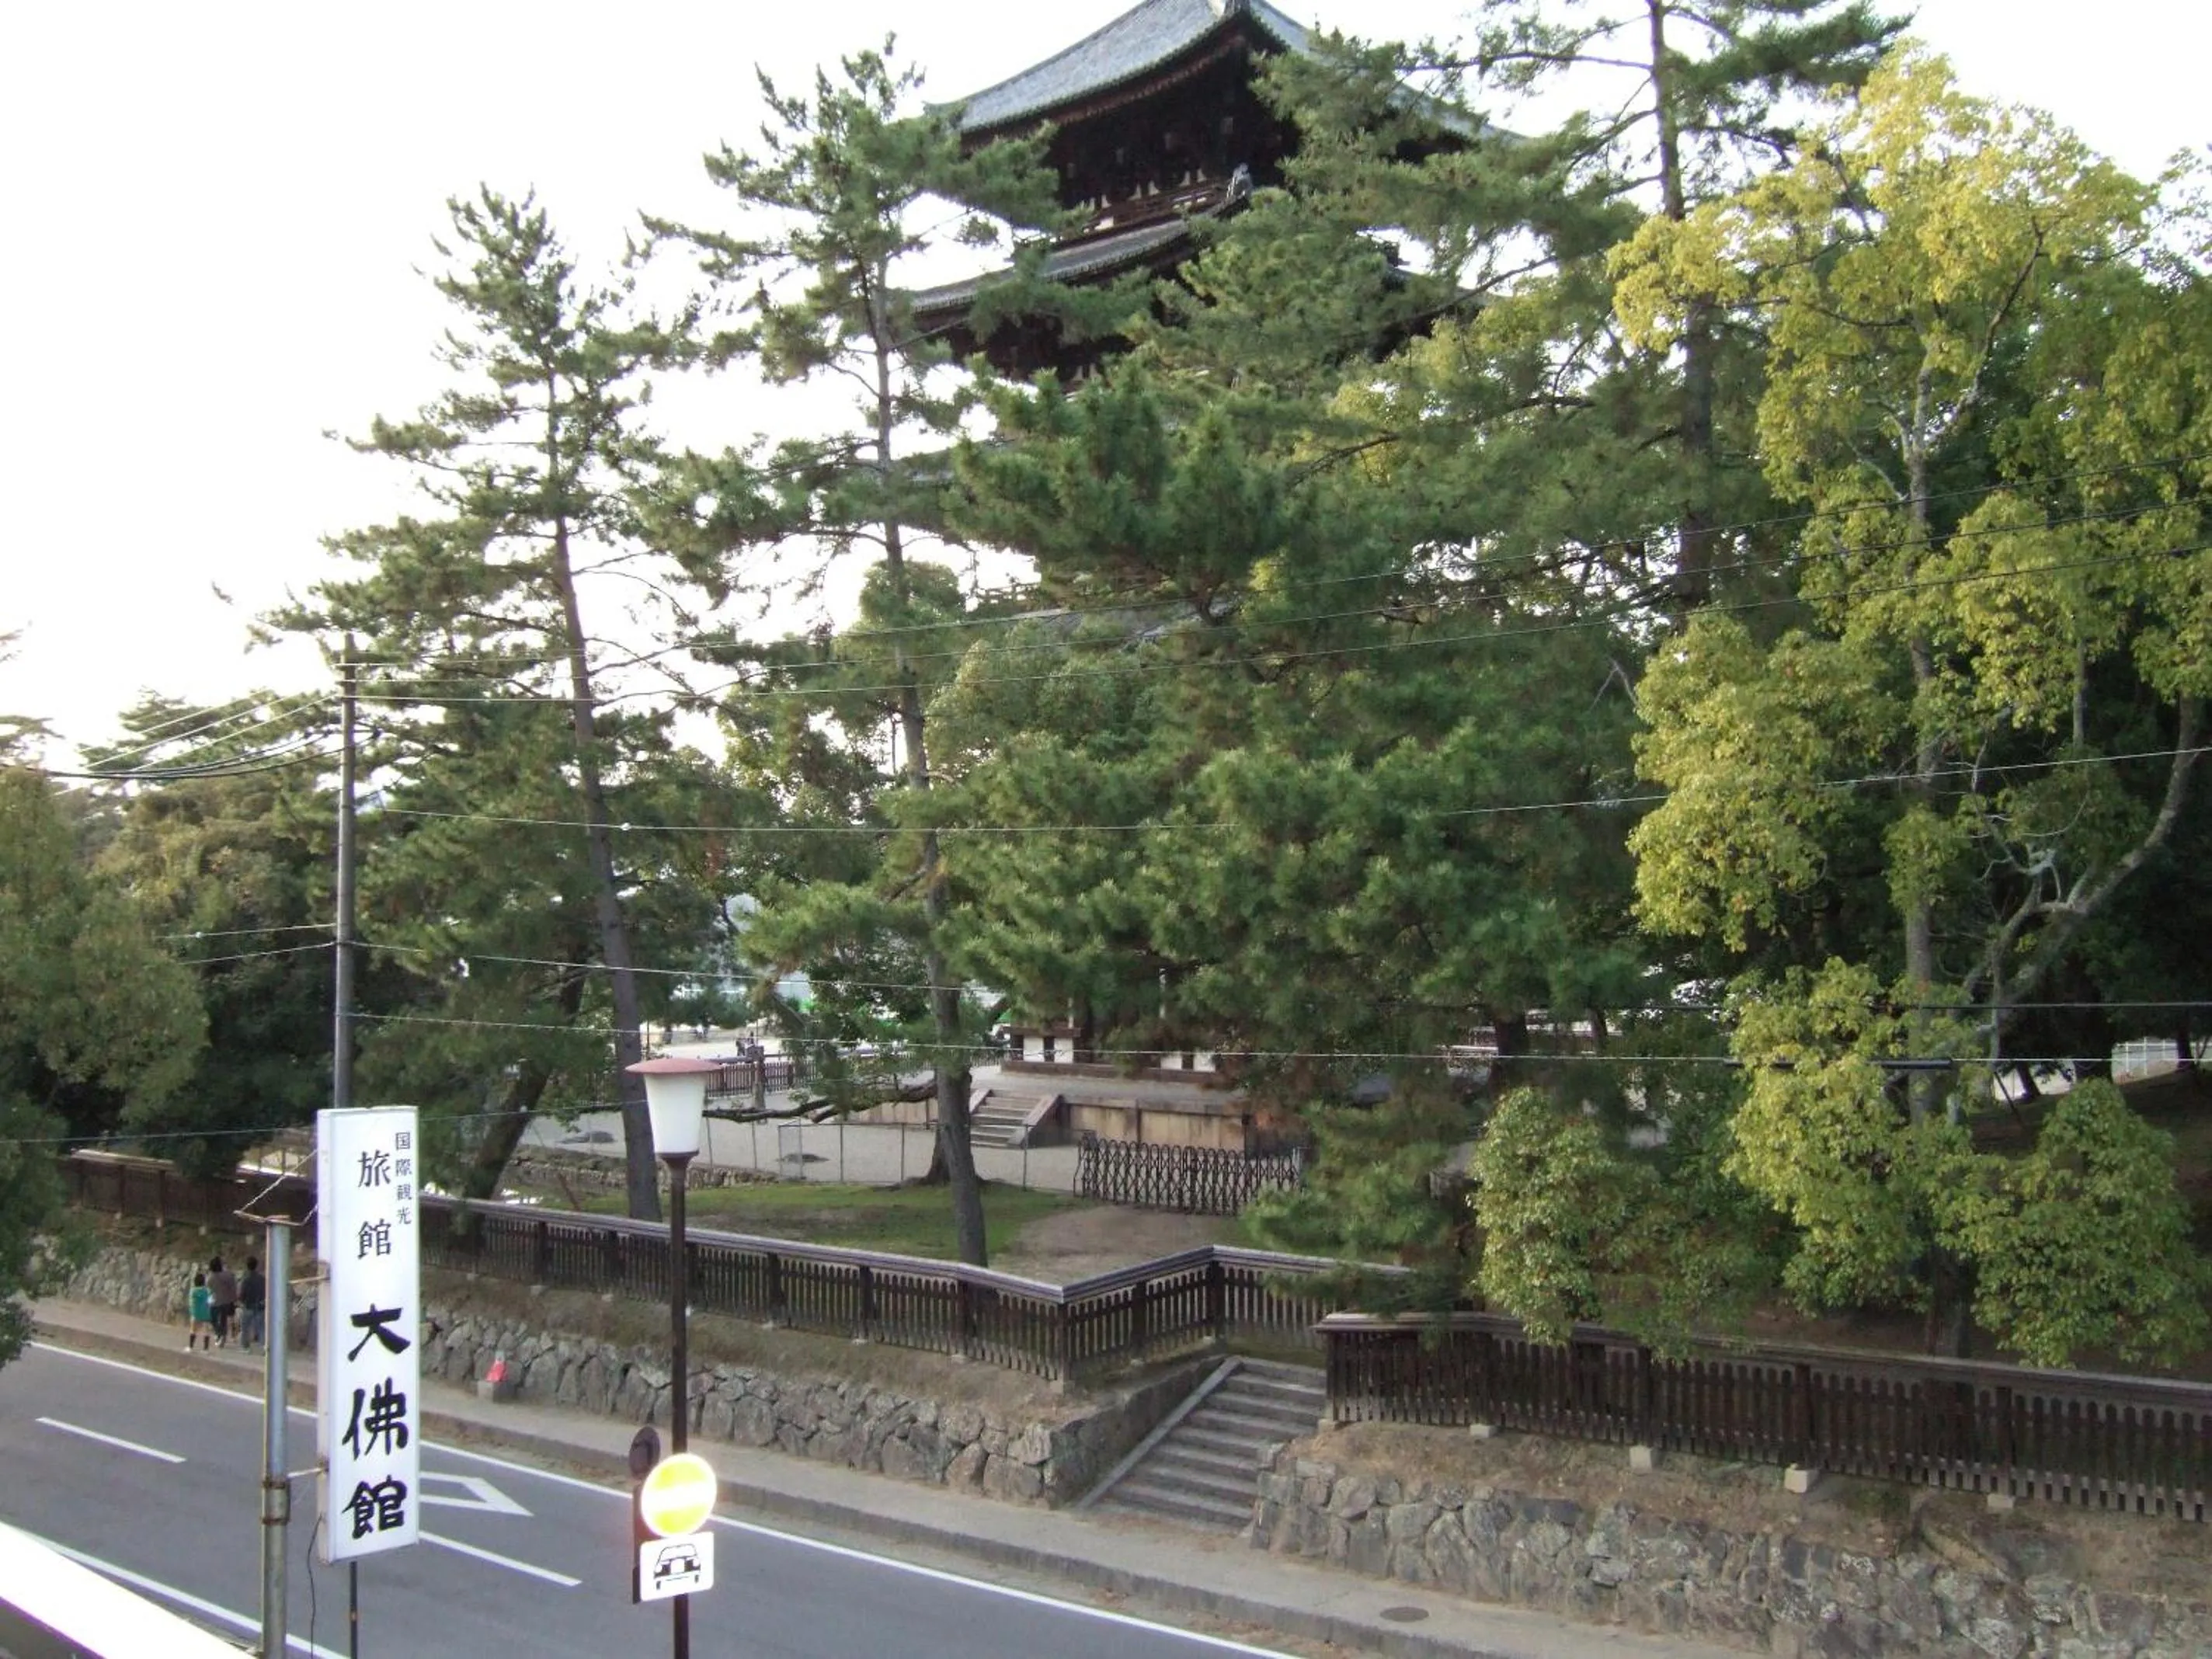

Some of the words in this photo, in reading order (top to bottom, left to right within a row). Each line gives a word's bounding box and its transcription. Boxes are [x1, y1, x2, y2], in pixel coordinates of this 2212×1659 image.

[357, 1149, 391, 1260] 旅館
[342, 1303, 411, 1539] 大佛館
